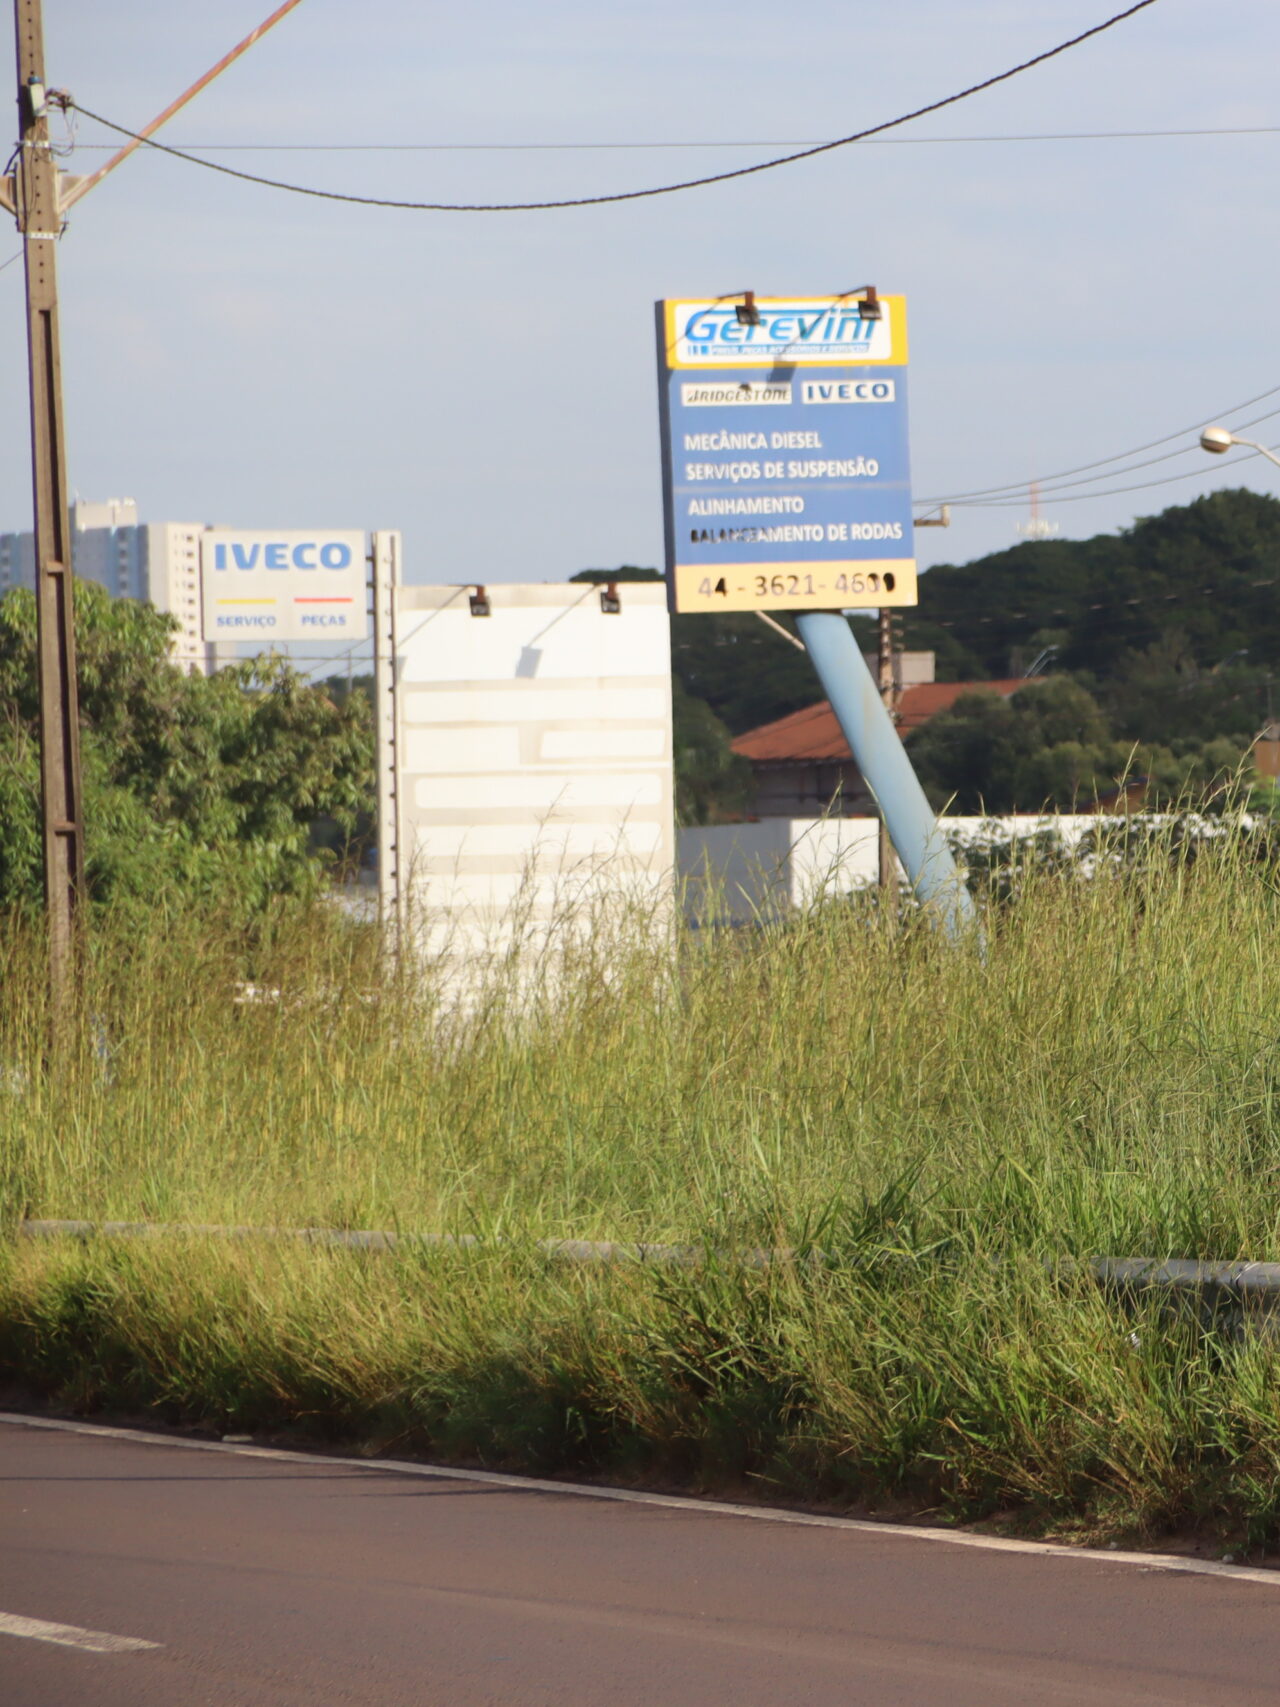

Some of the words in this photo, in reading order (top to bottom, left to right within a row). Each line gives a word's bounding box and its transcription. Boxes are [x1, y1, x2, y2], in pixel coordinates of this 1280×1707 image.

[685, 308, 877, 342] Gerevini
[807, 382, 890, 400] IVECO
[684, 429, 768, 451] MECÂNICA
[771, 431, 823, 449] DIESEL
[686, 461, 761, 483] SERVIÇOS
[764, 461, 785, 479] DE
[788, 456, 879, 478] SUSPENSÃO
[688, 496, 804, 516] ALINHAMENTO
[691, 524, 825, 544] BALANCEAMENTO
[828, 523, 849, 541] DE
[852, 522, 903, 541] RODAS
[215, 542, 352, 572] IVECO
[217, 614, 277, 629] SERVIÇO
[301, 613, 347, 628] PEÇAS
